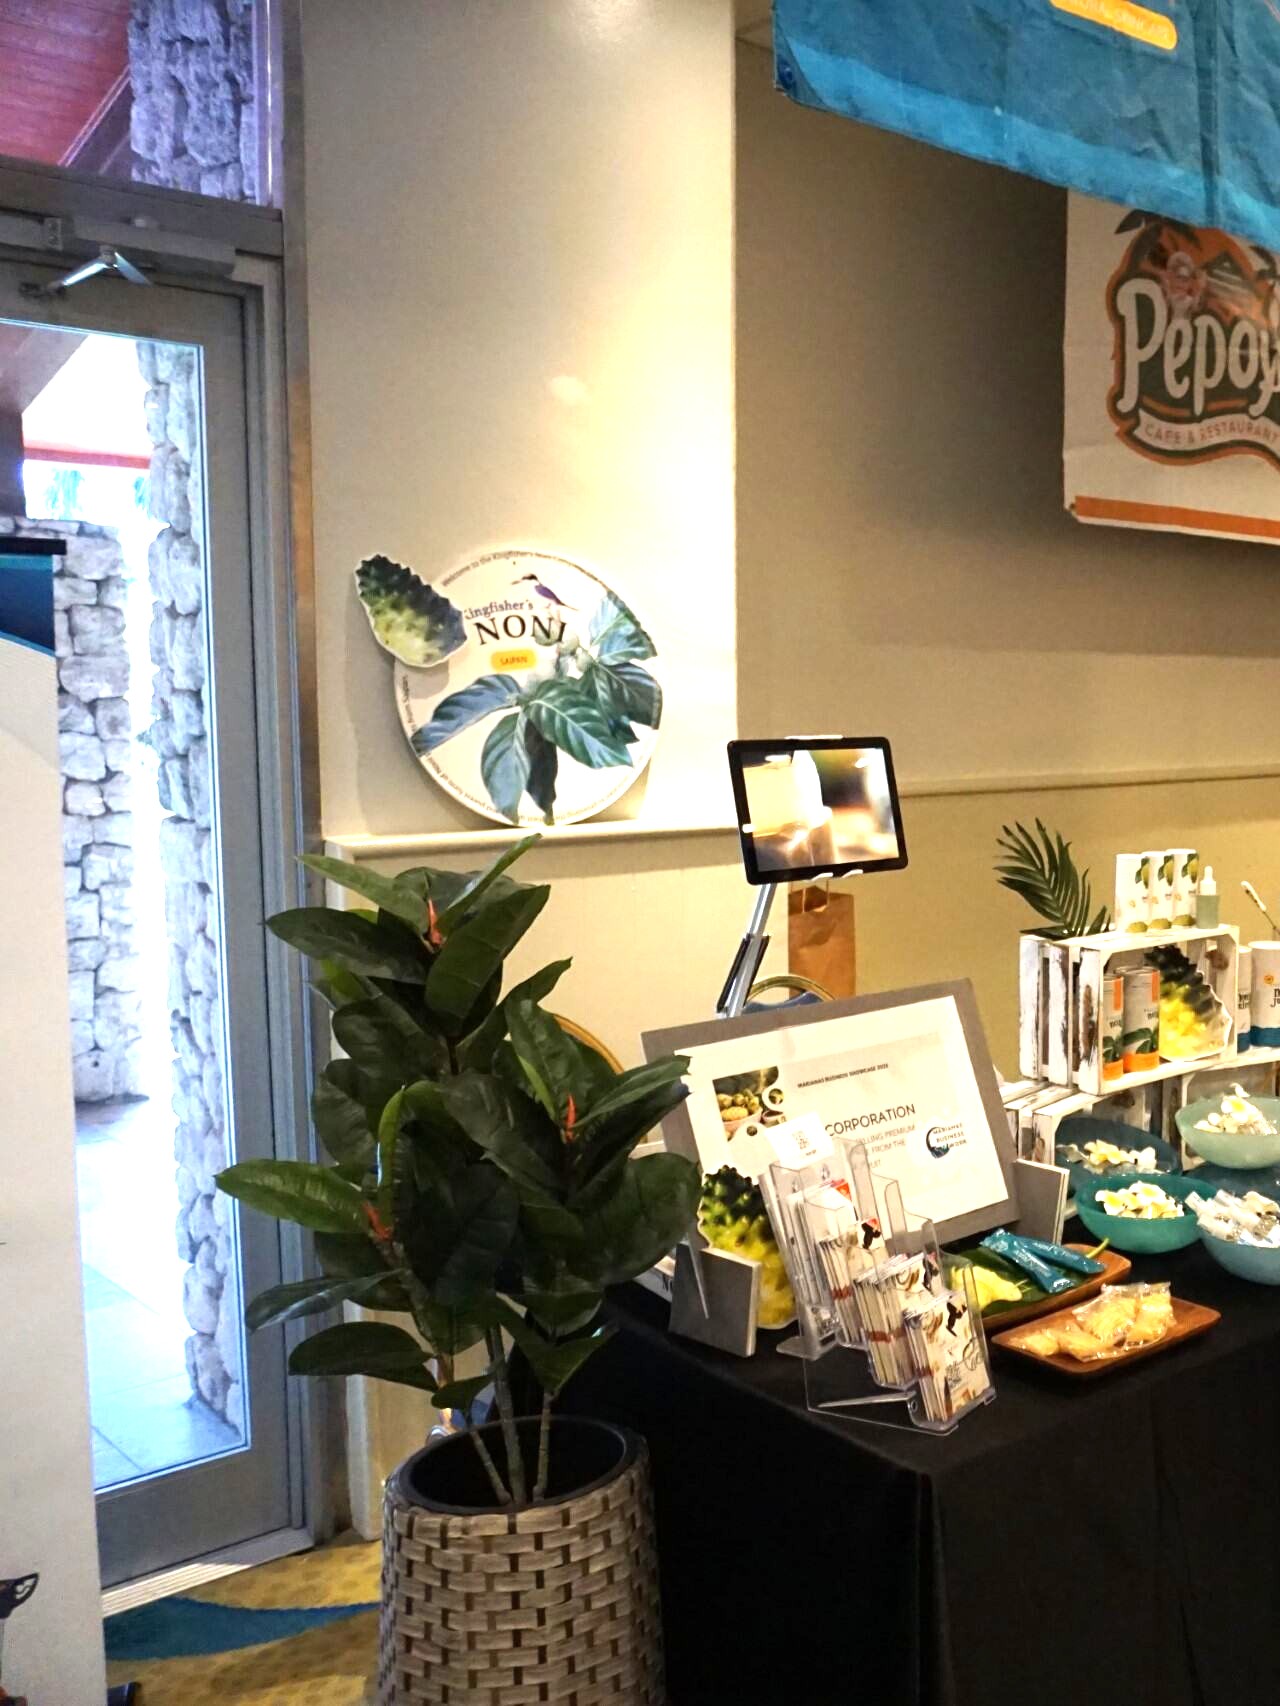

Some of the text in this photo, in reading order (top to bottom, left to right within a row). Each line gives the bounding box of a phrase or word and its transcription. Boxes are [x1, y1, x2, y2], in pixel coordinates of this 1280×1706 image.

[1144, 424, 1181, 444] CAFE
[474, 614, 567, 646] NONI
[825, 1104, 916, 1137] CORPORATION
